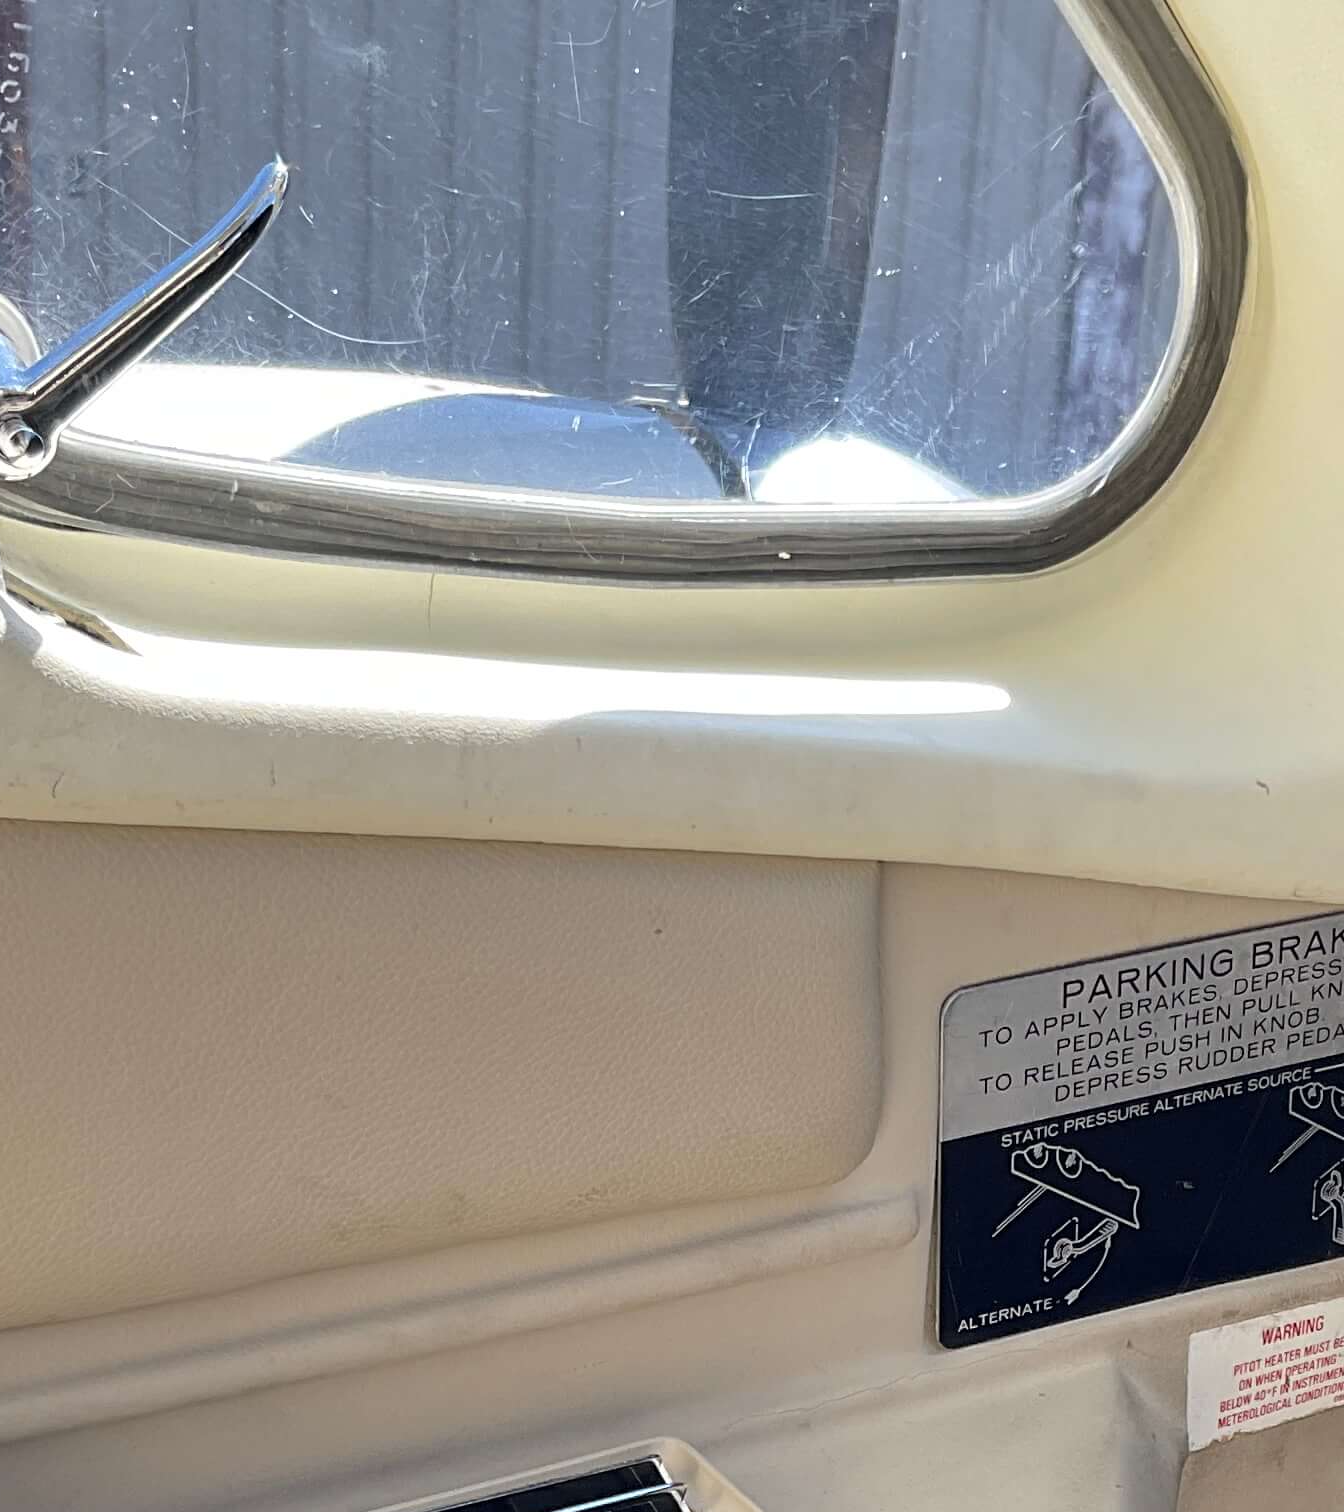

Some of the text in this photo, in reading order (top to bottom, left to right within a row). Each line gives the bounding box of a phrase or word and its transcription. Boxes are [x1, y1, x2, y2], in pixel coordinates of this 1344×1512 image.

[1062, 949, 1234, 1008] PARKING
[978, 1028, 1013, 1048] TO
[1024, 1006, 1109, 1040] APPLY
[1233, 959, 1342, 994] DEPRESS
[1056, 1025, 1158, 1056] PEDALS,
[1169, 1007, 1231, 1034] THEN
[1241, 993, 1301, 1019] PULL
[979, 1074, 1012, 1095] TO
[1023, 1050, 1133, 1084] RELEASE
[1144, 1035, 1210, 1059] PUSH
[1219, 1024, 1242, 1043] IN
[1055, 1063, 1167, 1102] DEPRESS
[1178, 1039, 1276, 1073] RUDDER
[1001, 1066, 1313, 1148] STATIC PRESSURE ALTERNATE SOURCE
[958, 1298, 1053, 1333] ALTERNATE
[1262, 1316, 1324, 1345] WARNING
[1234, 1336, 1344, 1376] PITOT HEATER MUST BE
[1239, 1357, 1336, 1391] ON WHEN OPERATING
[1218, 1398, 1292, 1428] METEROLOGICAL
[1220, 1395, 1251, 1412] BELOW
[1280, 1383, 1289, 1394] IN
